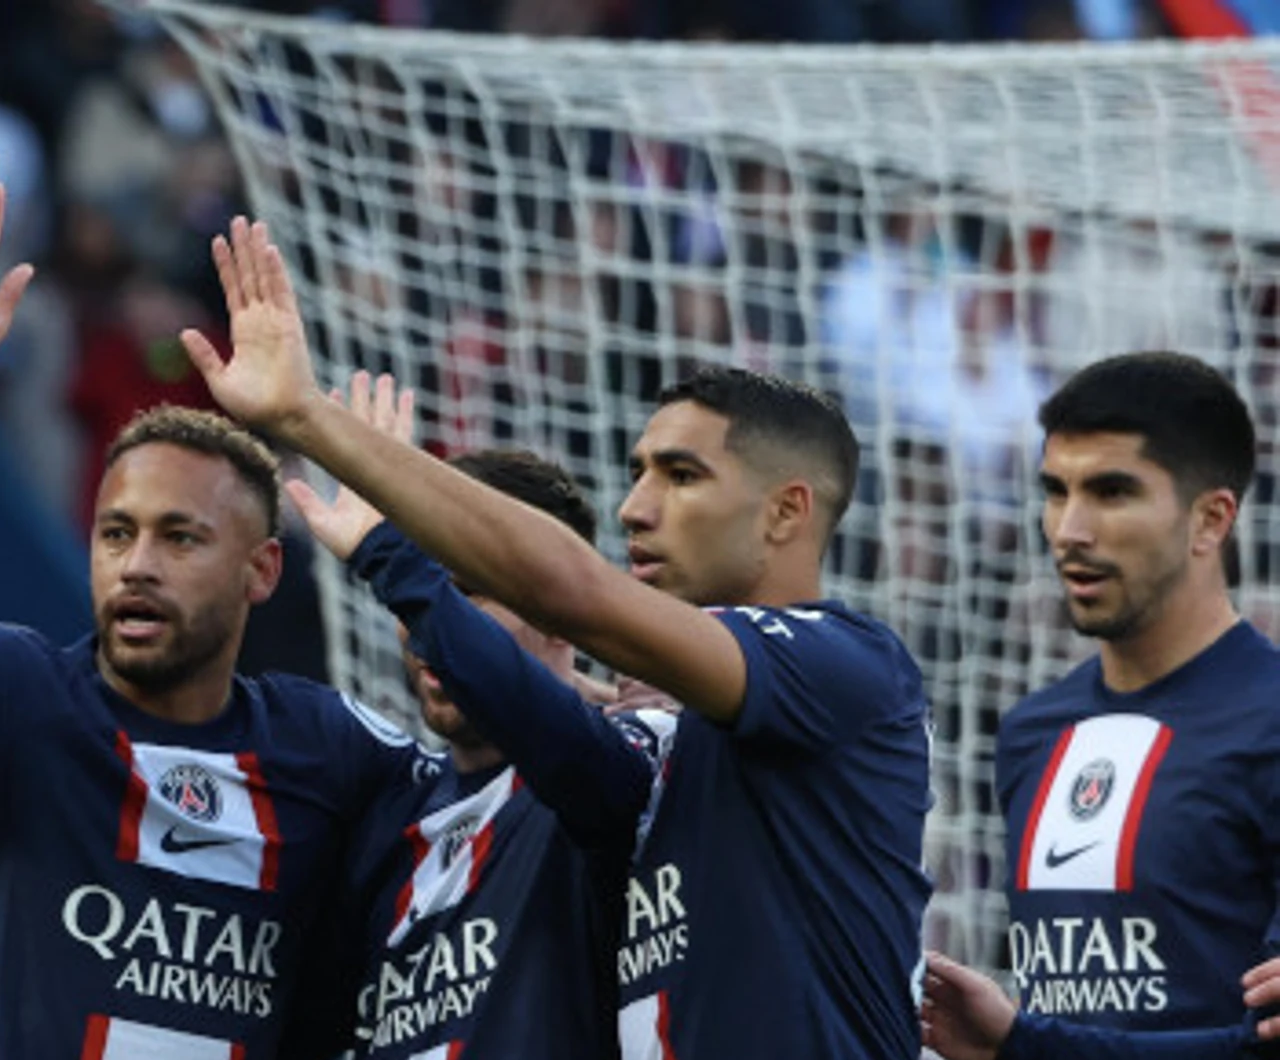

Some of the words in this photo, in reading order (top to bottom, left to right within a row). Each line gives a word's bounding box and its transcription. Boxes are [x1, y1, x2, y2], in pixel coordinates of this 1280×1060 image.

[62, 884, 282, 978] QATAR
[1008, 917, 1167, 988] QATAR
[115, 957, 273, 1018] AIRWAYS
[1027, 976, 1168, 1015] AIRWAYS
